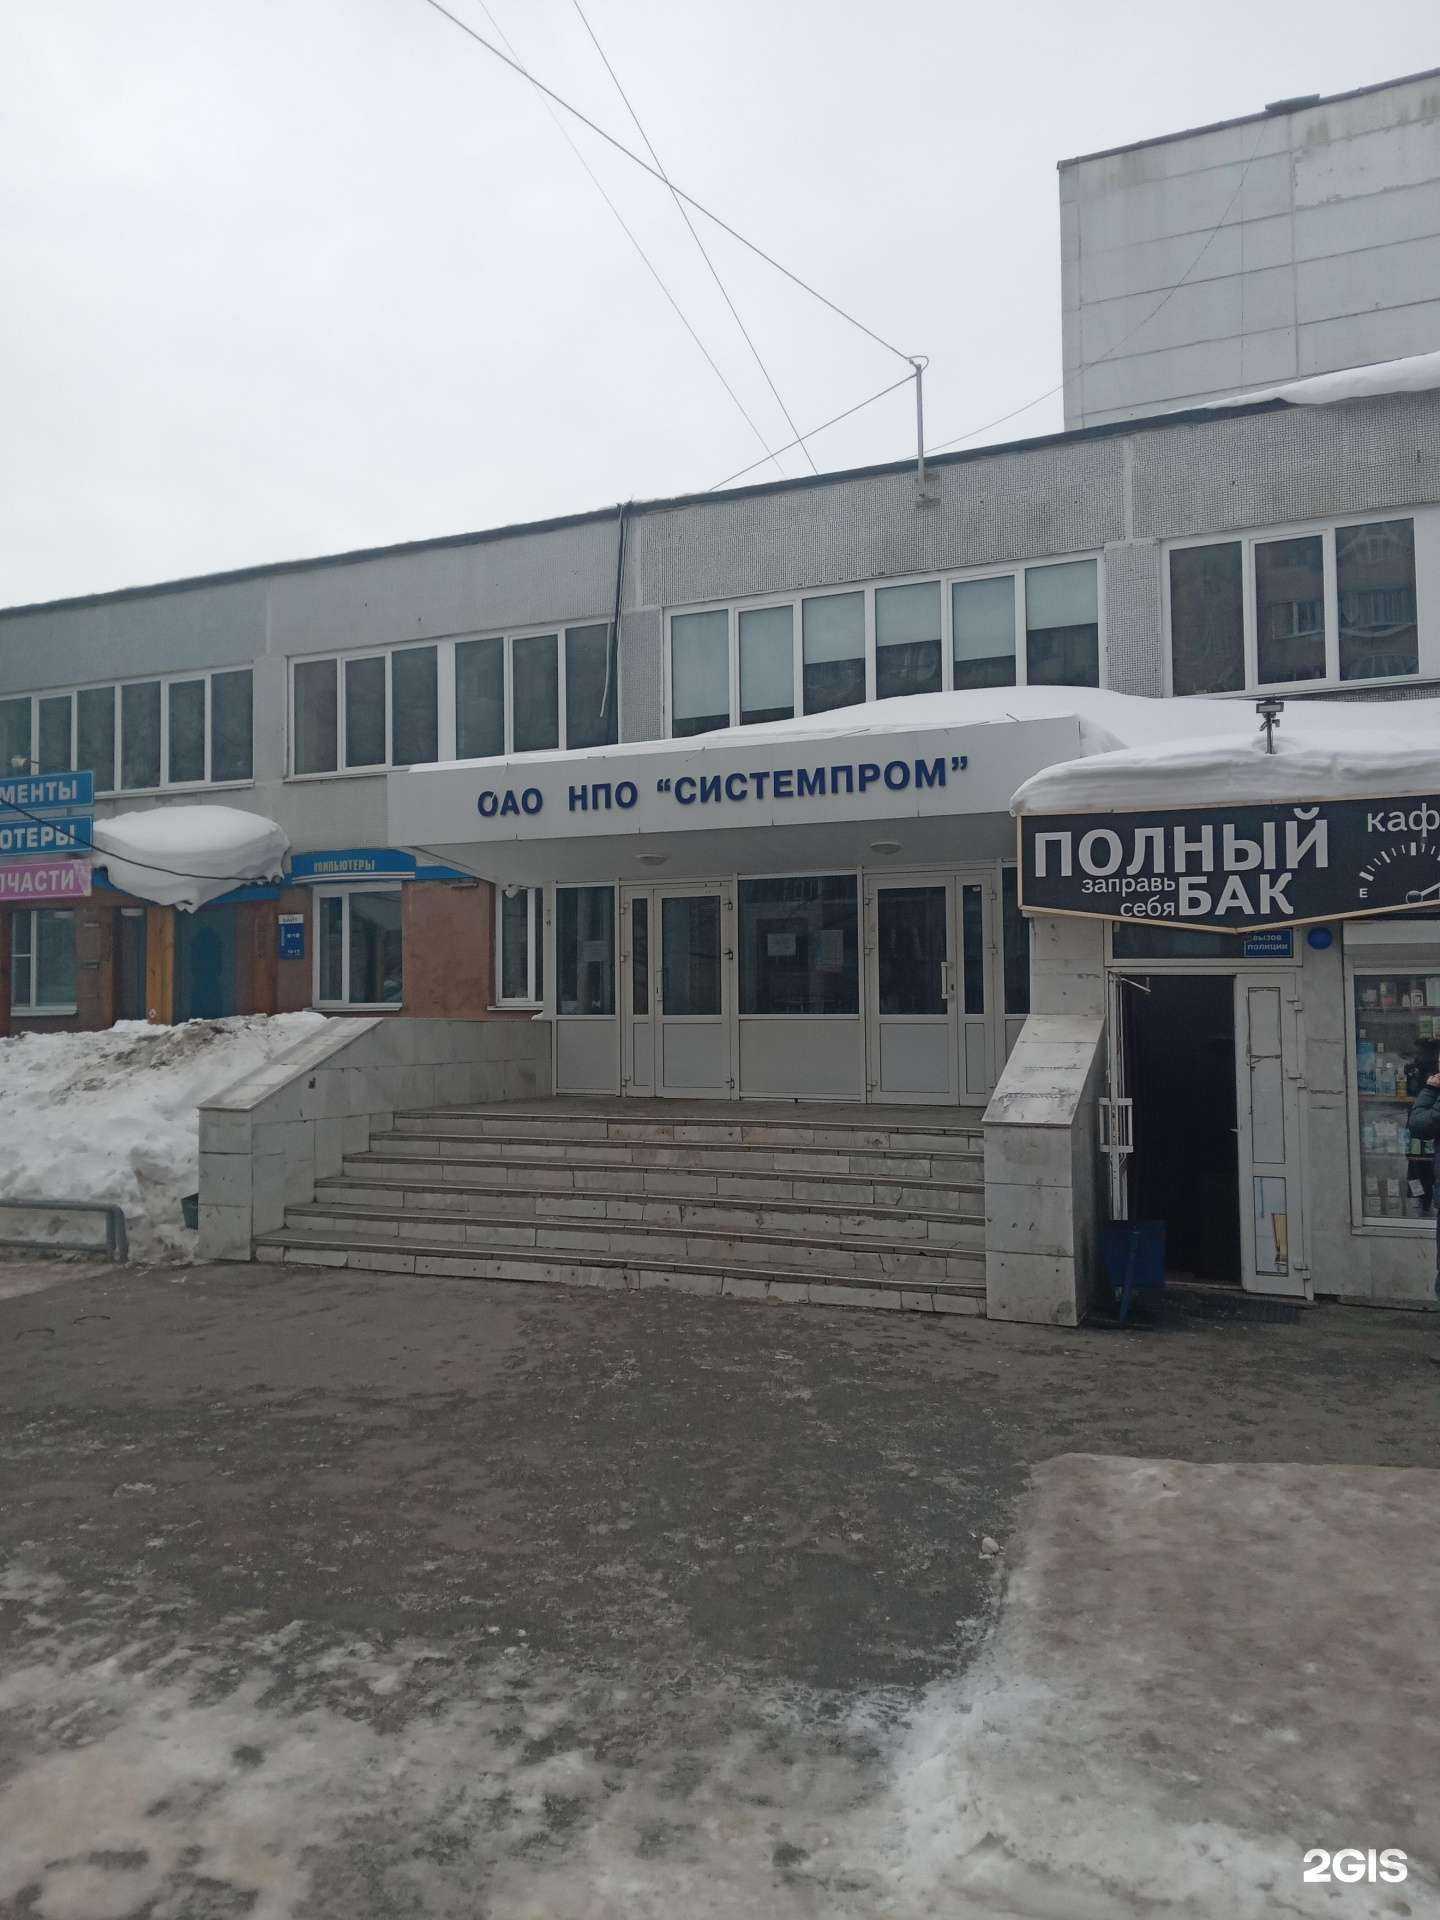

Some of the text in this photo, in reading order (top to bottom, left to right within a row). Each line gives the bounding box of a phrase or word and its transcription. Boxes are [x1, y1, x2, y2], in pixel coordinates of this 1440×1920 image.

[0, 779, 77, 804] МЕНТЫ
[477, 787, 543, 817] ОАО
[568, 780, 638, 812] НПО
[1367, 802, 1440, 837] каф
[0, 824, 75, 849] ОТЕРЫ
[1034, 806, 1329, 877] ПОЛНЫЙ
[1081, 876, 1176, 897] заправь
[1178, 872, 1294, 916] БАК
[1119, 894, 1176, 917] себя
